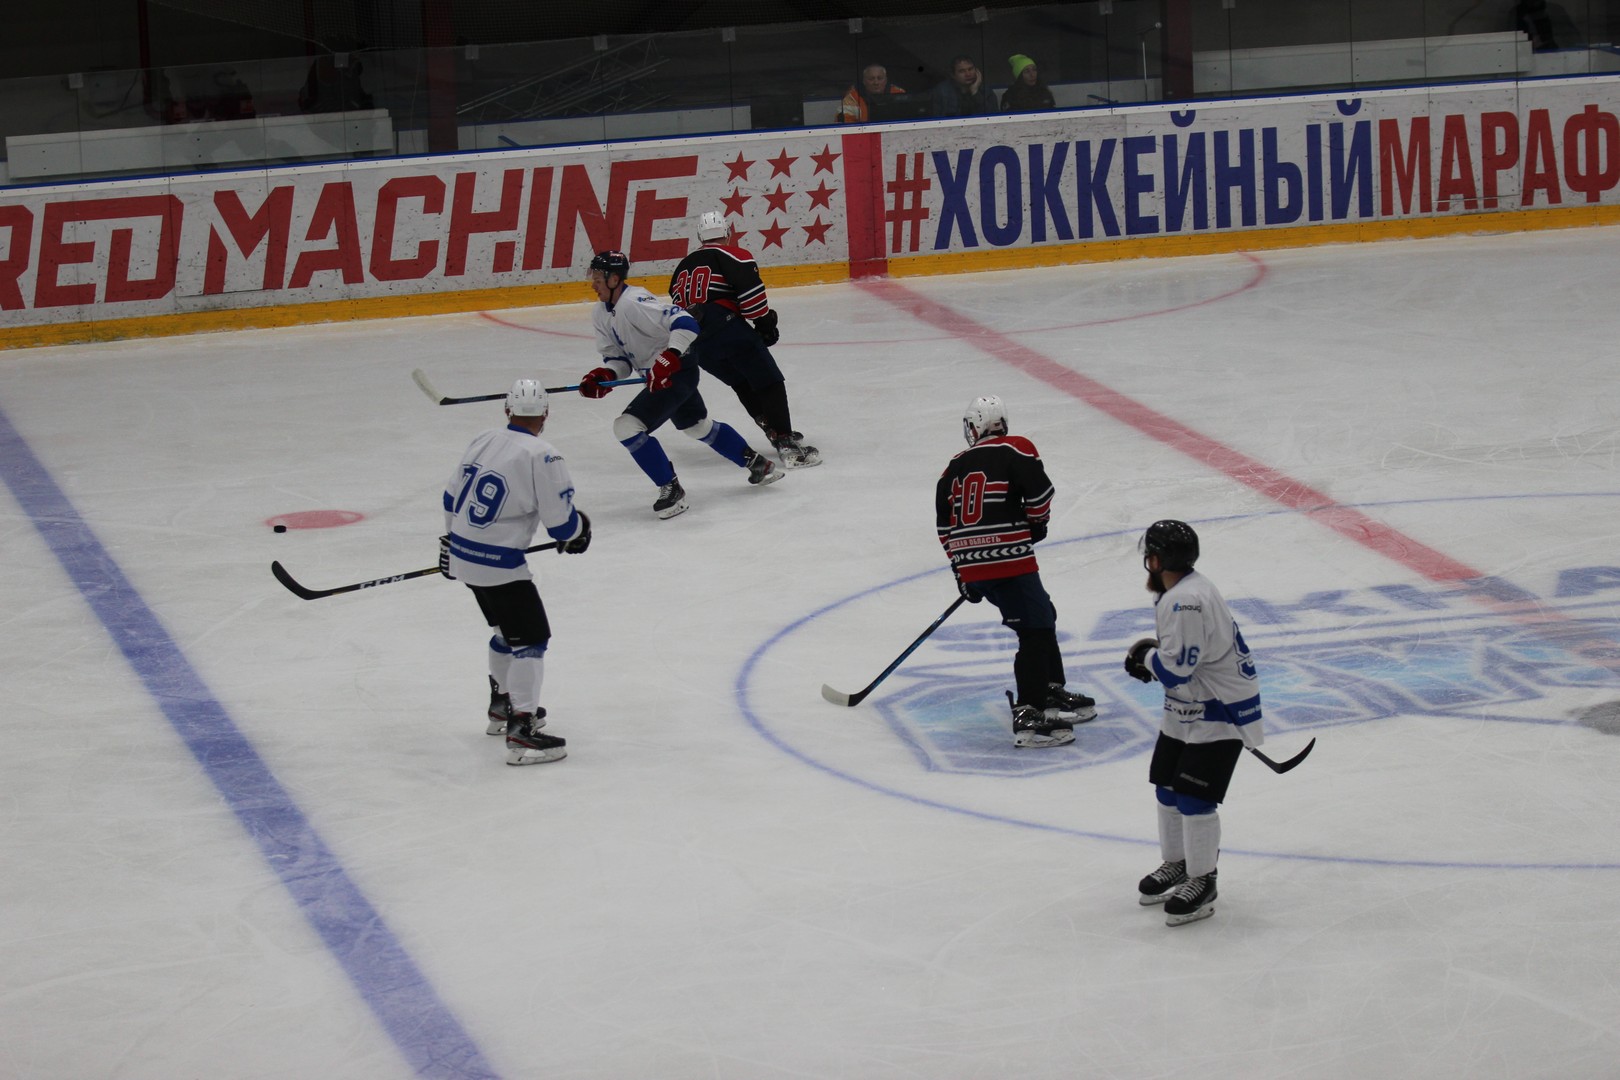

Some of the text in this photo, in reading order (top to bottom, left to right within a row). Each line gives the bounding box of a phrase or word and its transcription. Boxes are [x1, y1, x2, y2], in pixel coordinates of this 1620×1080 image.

[203, 155, 698, 296] MACHINE
[453, 462, 510, 530] 79
[359, 574, 406, 590] CCM
